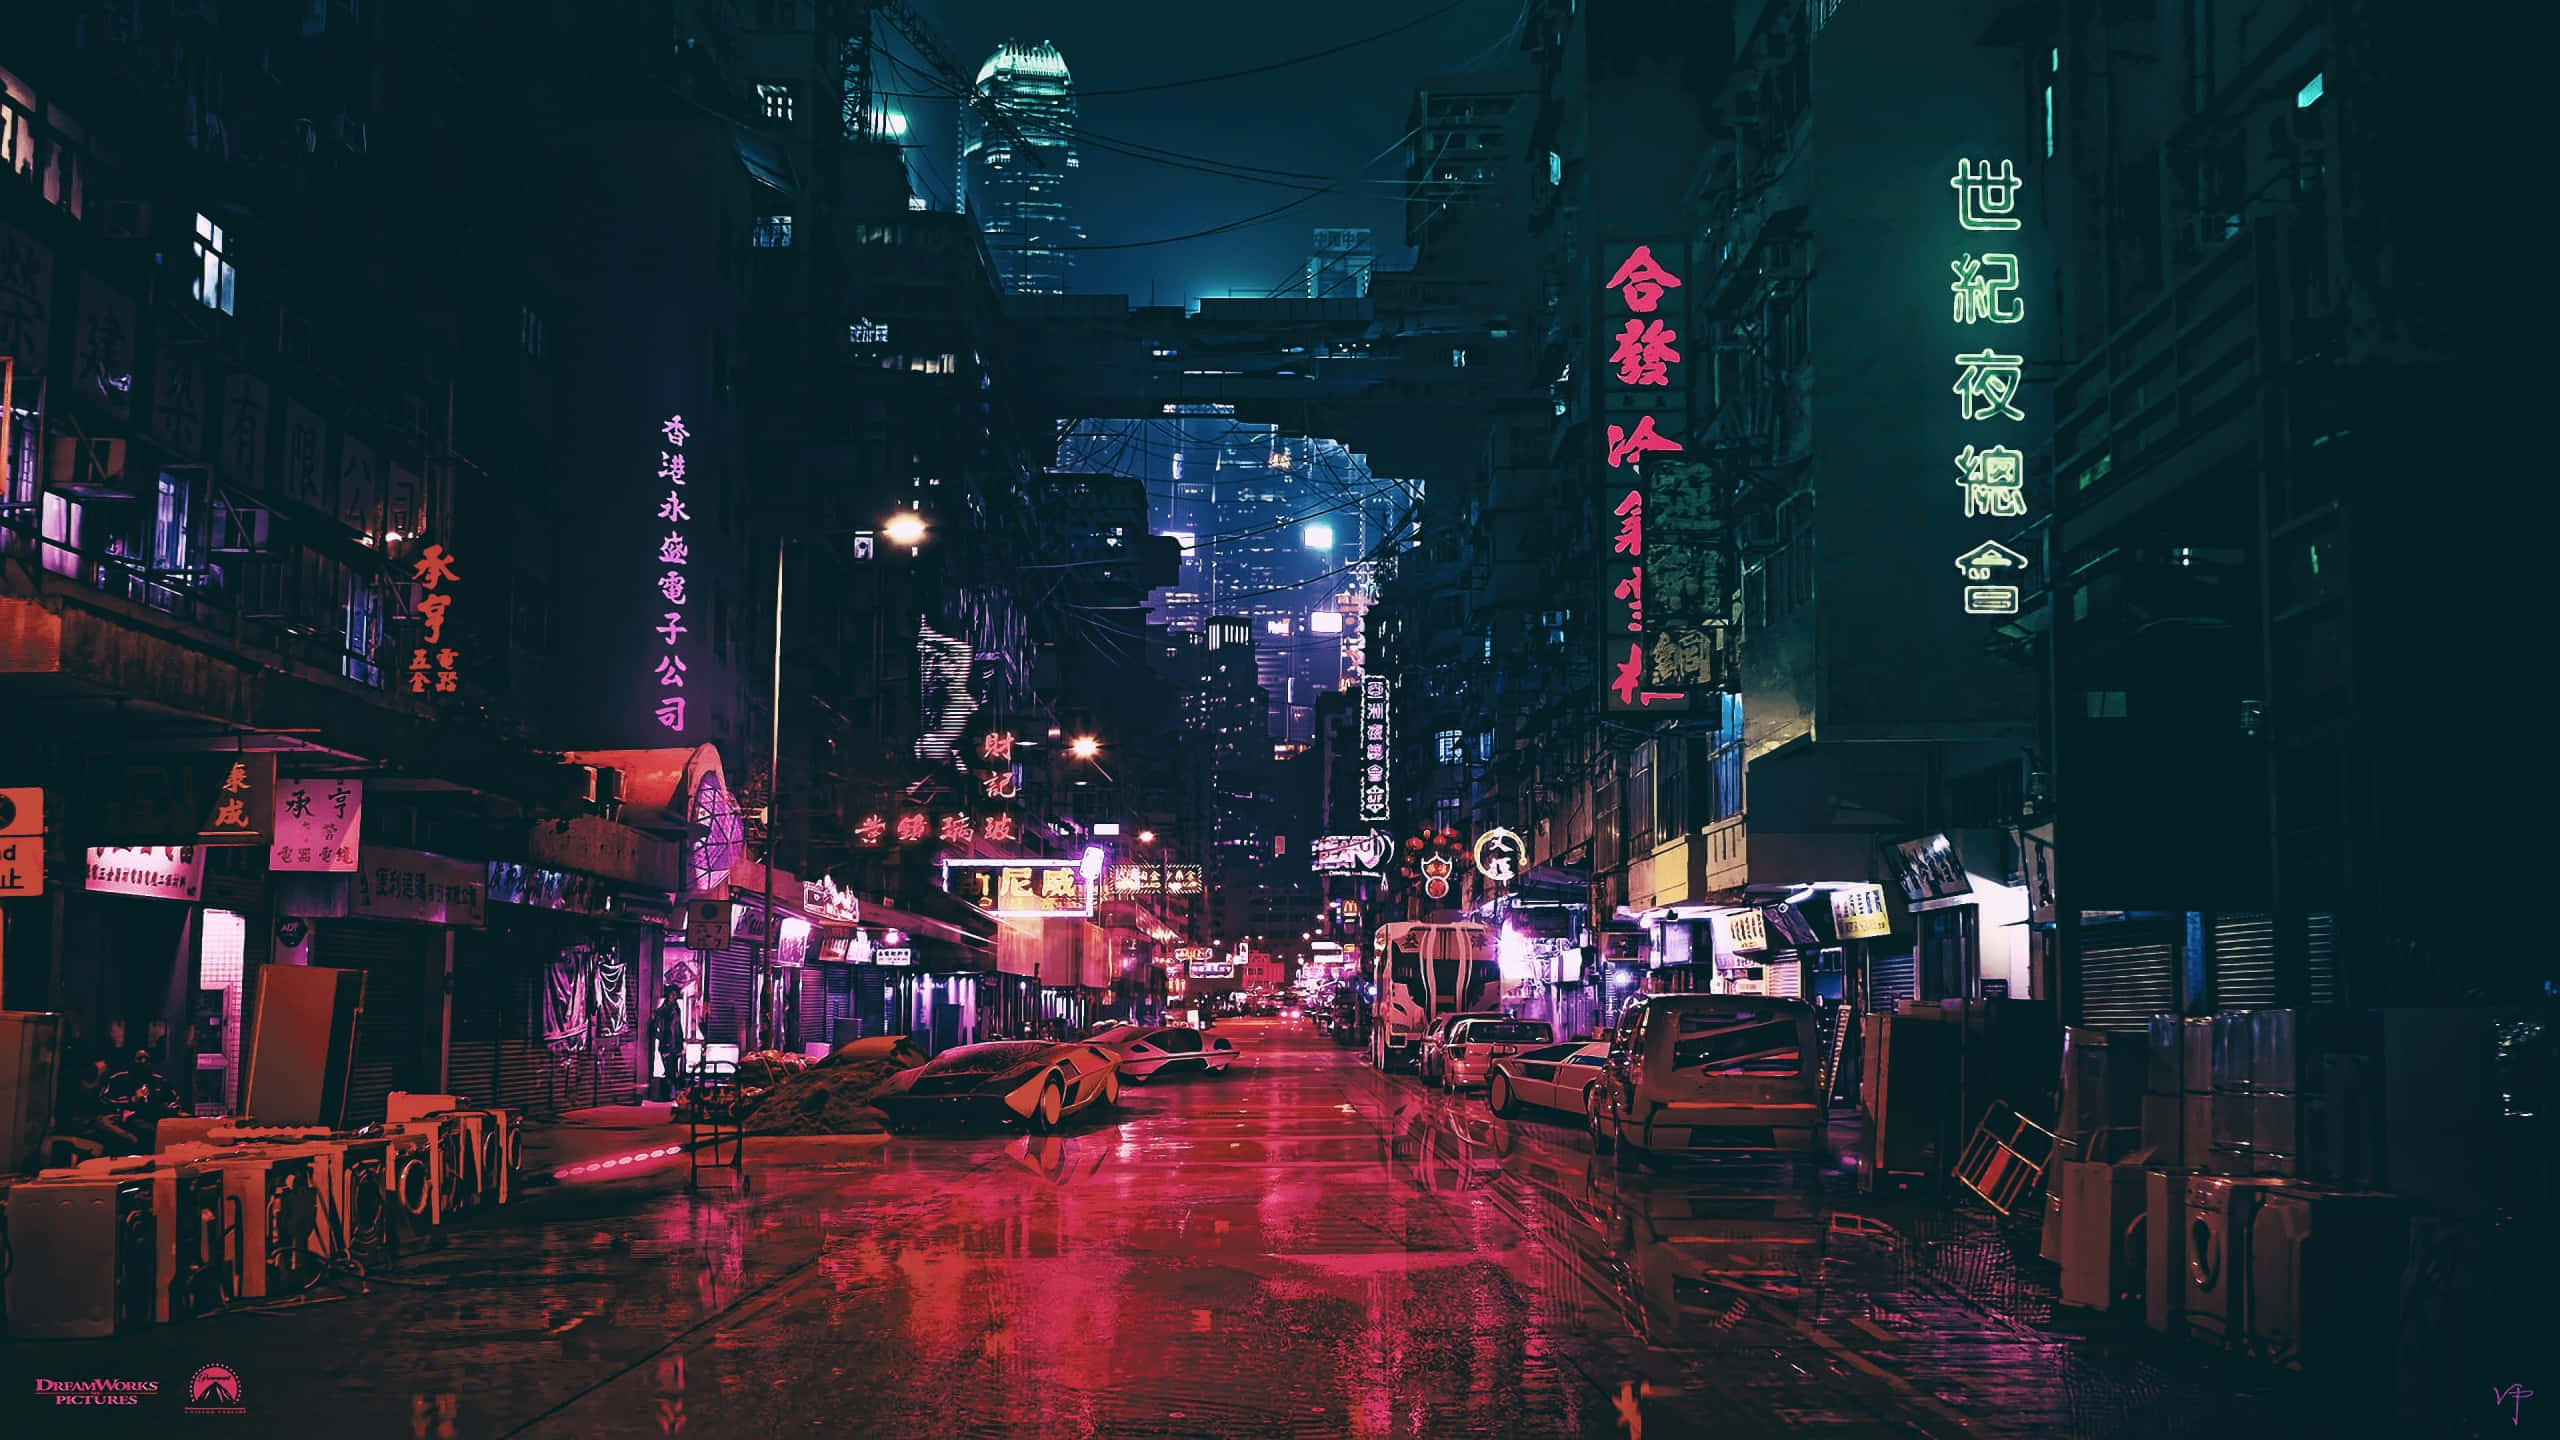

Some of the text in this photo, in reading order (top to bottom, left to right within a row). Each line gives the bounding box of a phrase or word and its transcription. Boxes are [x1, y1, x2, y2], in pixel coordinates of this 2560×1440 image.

[654, 413, 692, 733] 香港永盛電子公司
[1950, 157, 2029, 616] 世紀夜總會
